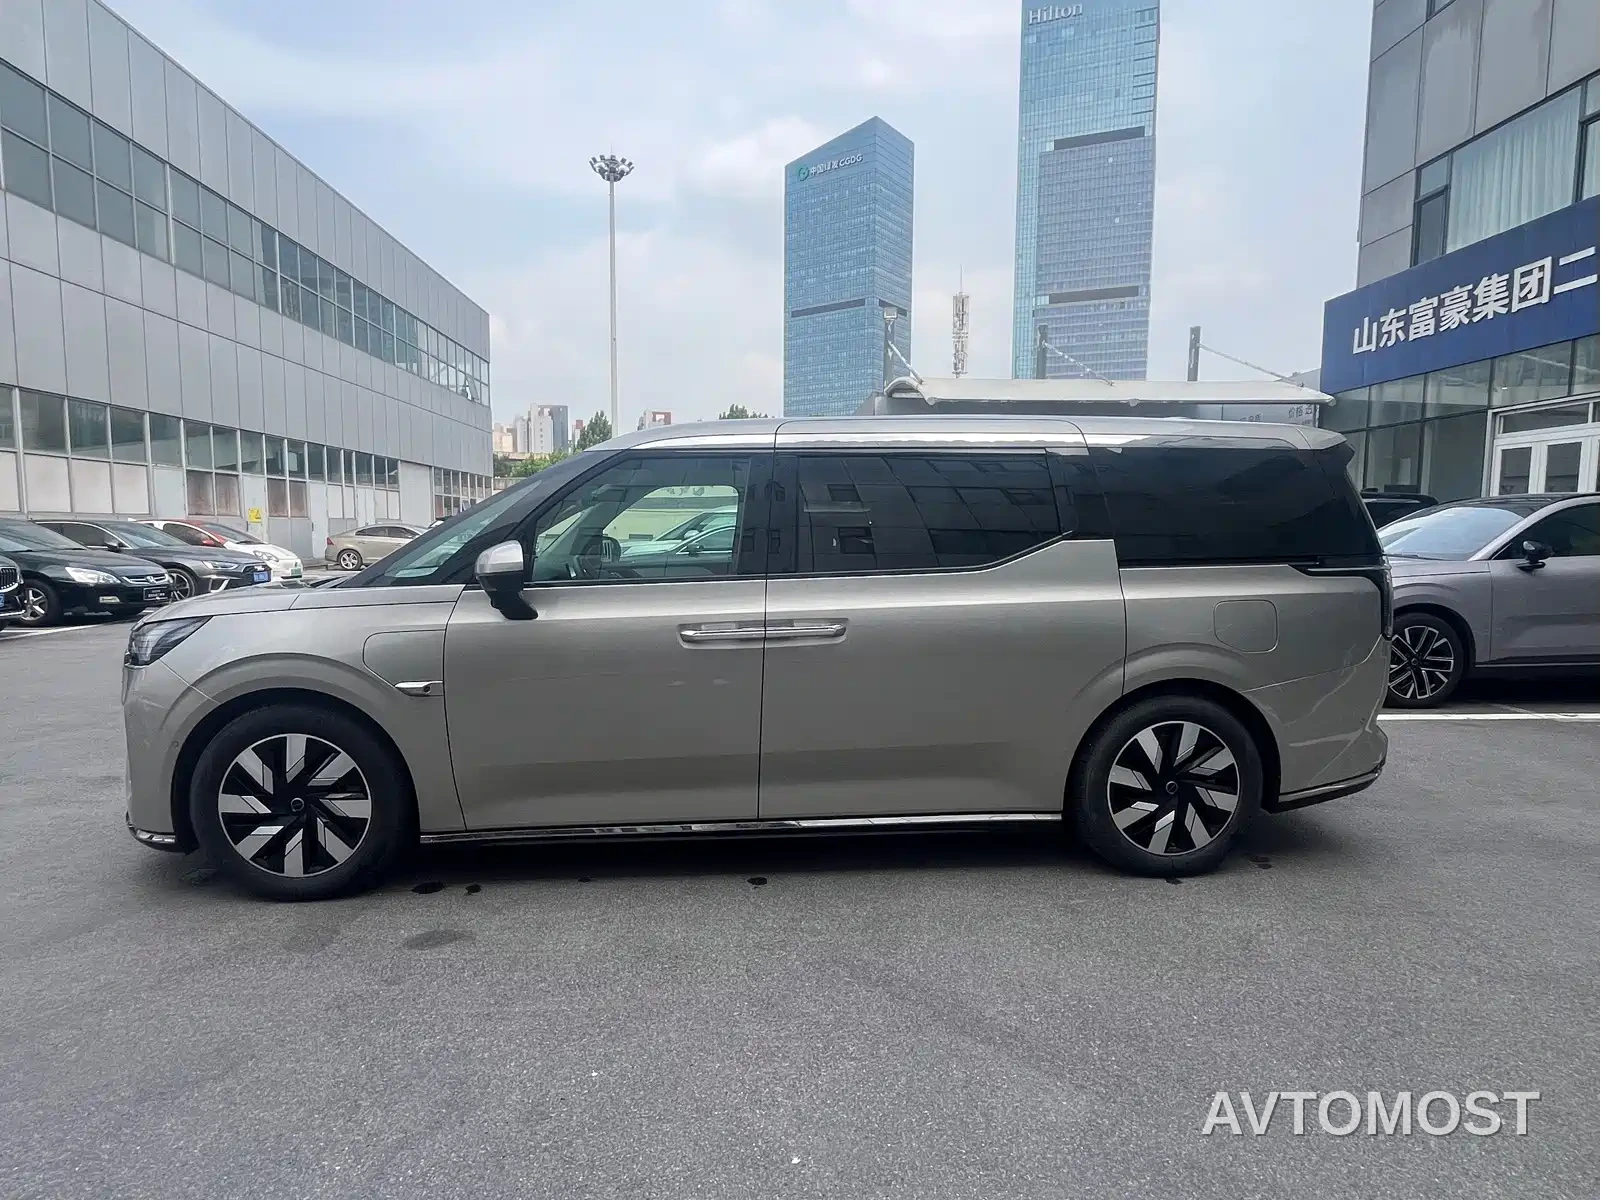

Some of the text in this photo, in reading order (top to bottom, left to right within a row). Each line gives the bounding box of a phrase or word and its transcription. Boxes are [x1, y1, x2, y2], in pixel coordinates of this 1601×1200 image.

[1028, 3, 1083, 25] Hilton
[1352, 246, 1598, 355] 山东富豪集团二
